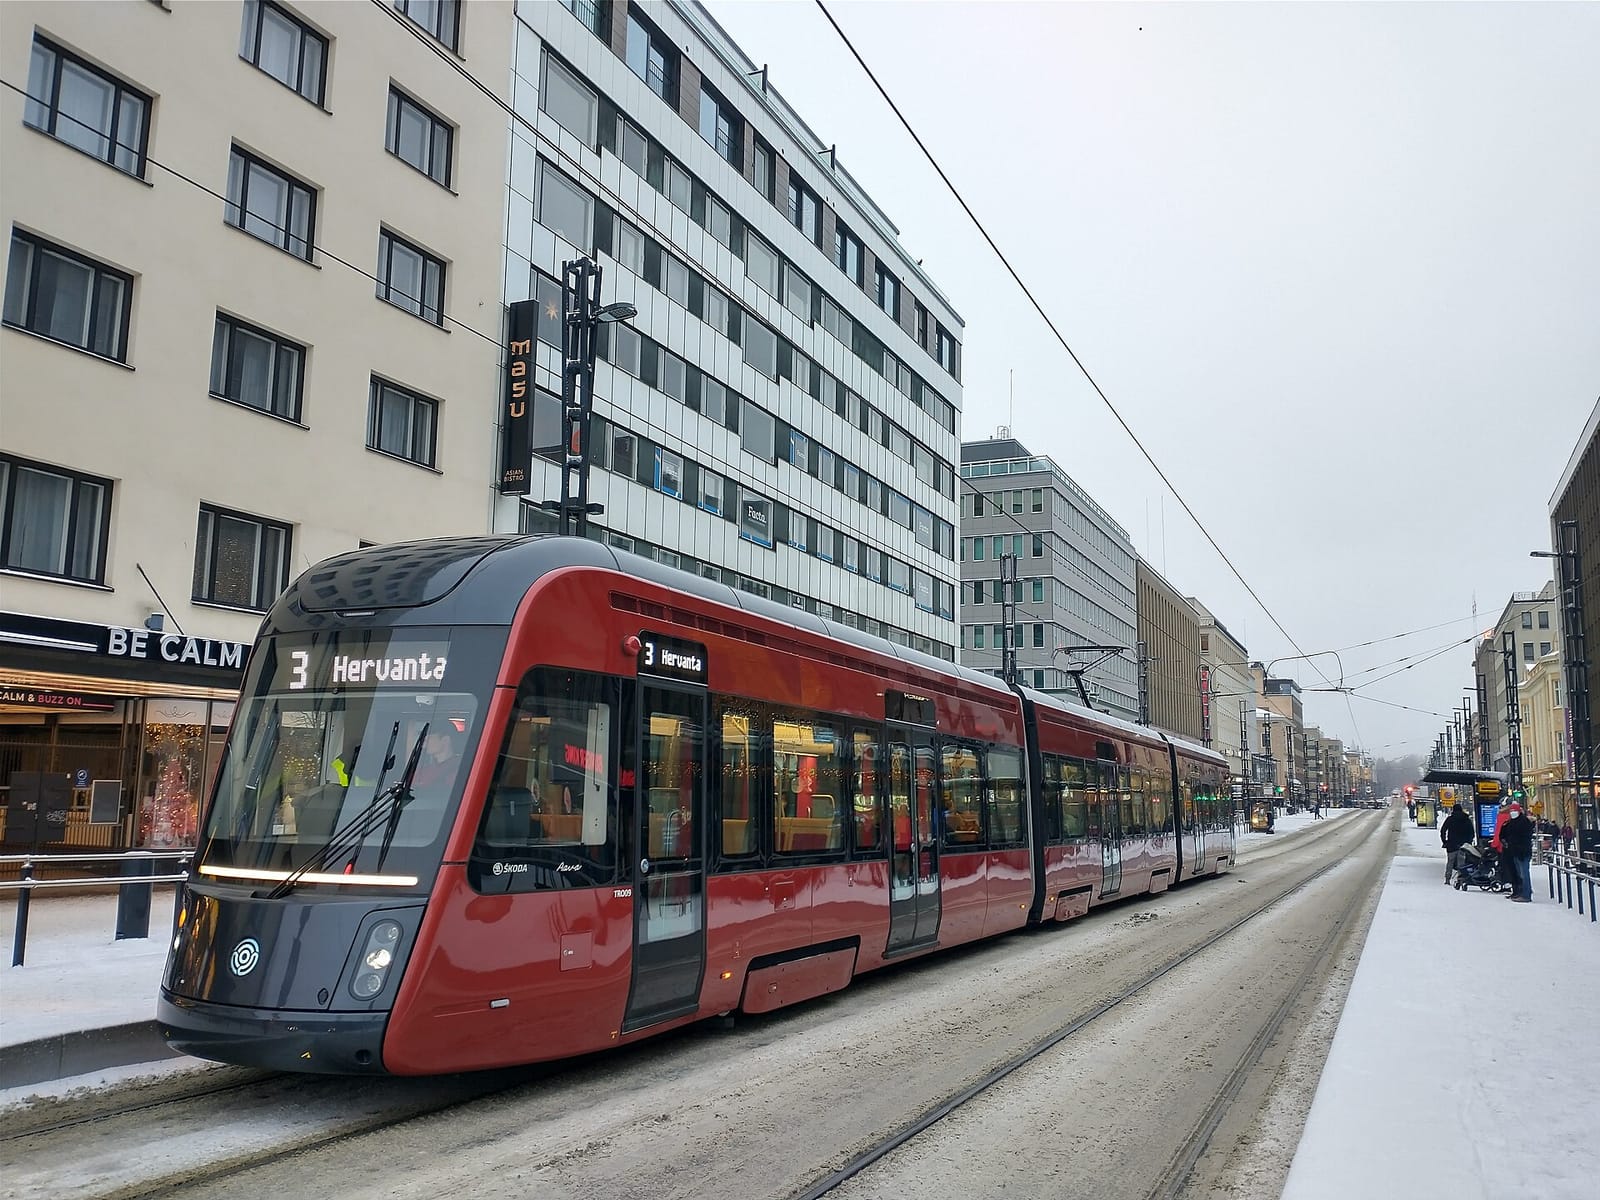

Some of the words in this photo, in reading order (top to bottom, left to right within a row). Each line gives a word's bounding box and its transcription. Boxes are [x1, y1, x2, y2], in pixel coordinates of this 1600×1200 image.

[510, 339, 531, 418] masu
[108, 627, 149, 658] BE
[160, 634, 242, 668] CALM
[644, 642, 654, 666] 3
[661, 649, 702, 672] Hervanta
[289, 651, 309, 690] 3
[332, 653, 447, 683] Hervanta
[37, 694, 64, 705] BUZZ
[66, 696, 82, 706] ON
